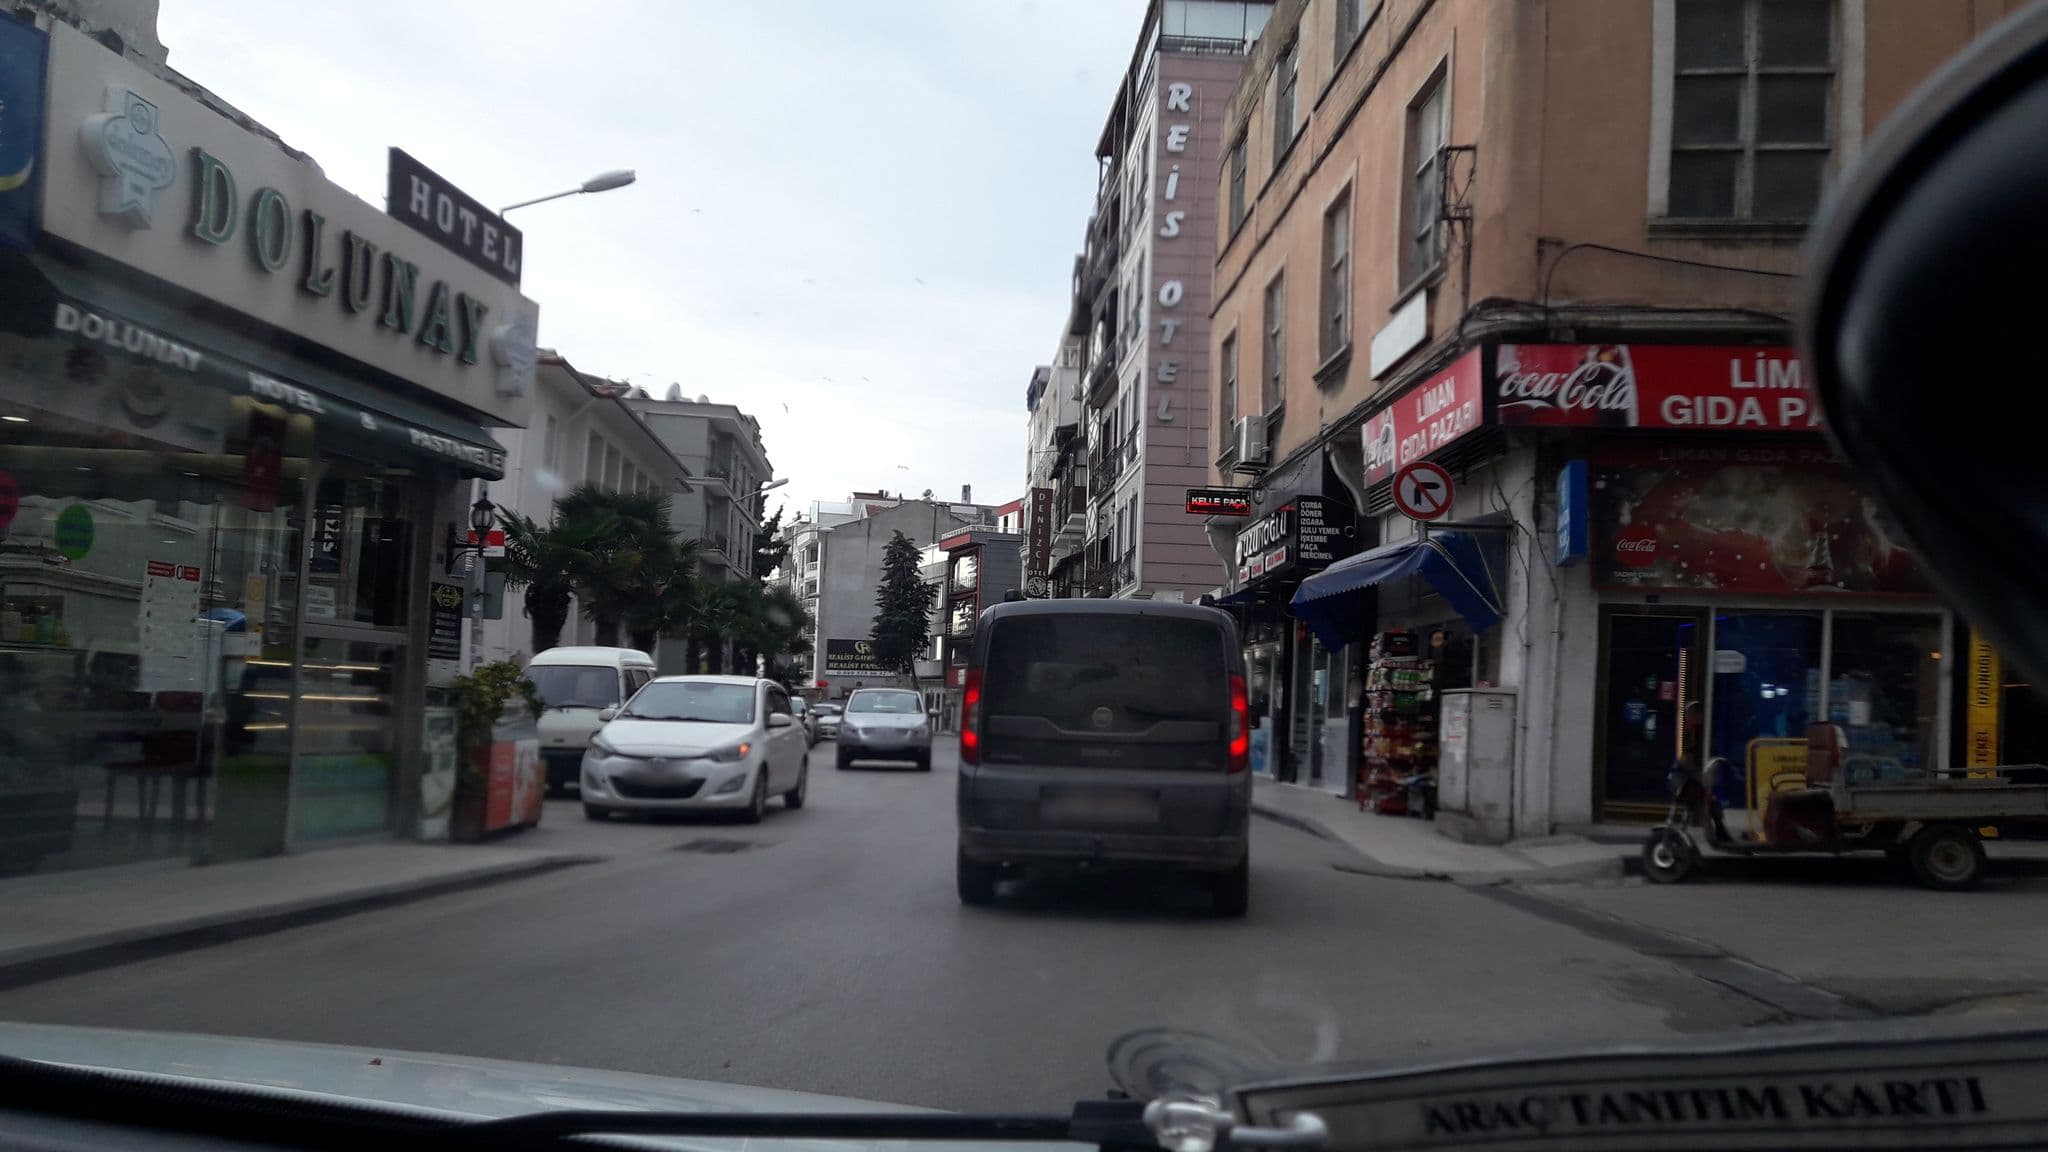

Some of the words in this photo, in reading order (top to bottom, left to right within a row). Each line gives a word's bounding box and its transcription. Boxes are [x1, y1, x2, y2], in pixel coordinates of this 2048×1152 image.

[409, 173, 517, 275] HOTEL
[190, 147, 489, 365] DOLUNAY
[54, 302, 202, 372] DOLUNAY
[248, 371, 326, 414] HOTEL
[1156, 279, 1184, 421] OTEL
[1730, 351, 1808, 389] LİM
[1415, 376, 1456, 424] LİMAN
[1660, 395, 1768, 425] GIDA
[1400, 428, 1428, 465] GIDA
[1616, 538, 1657, 553] Coca-Cola
[1422, 1097, 1548, 1137] ARAÇ
[1559, 1084, 1788, 1125] TANITIM
[1794, 1078, 1985, 1119] KARTI
